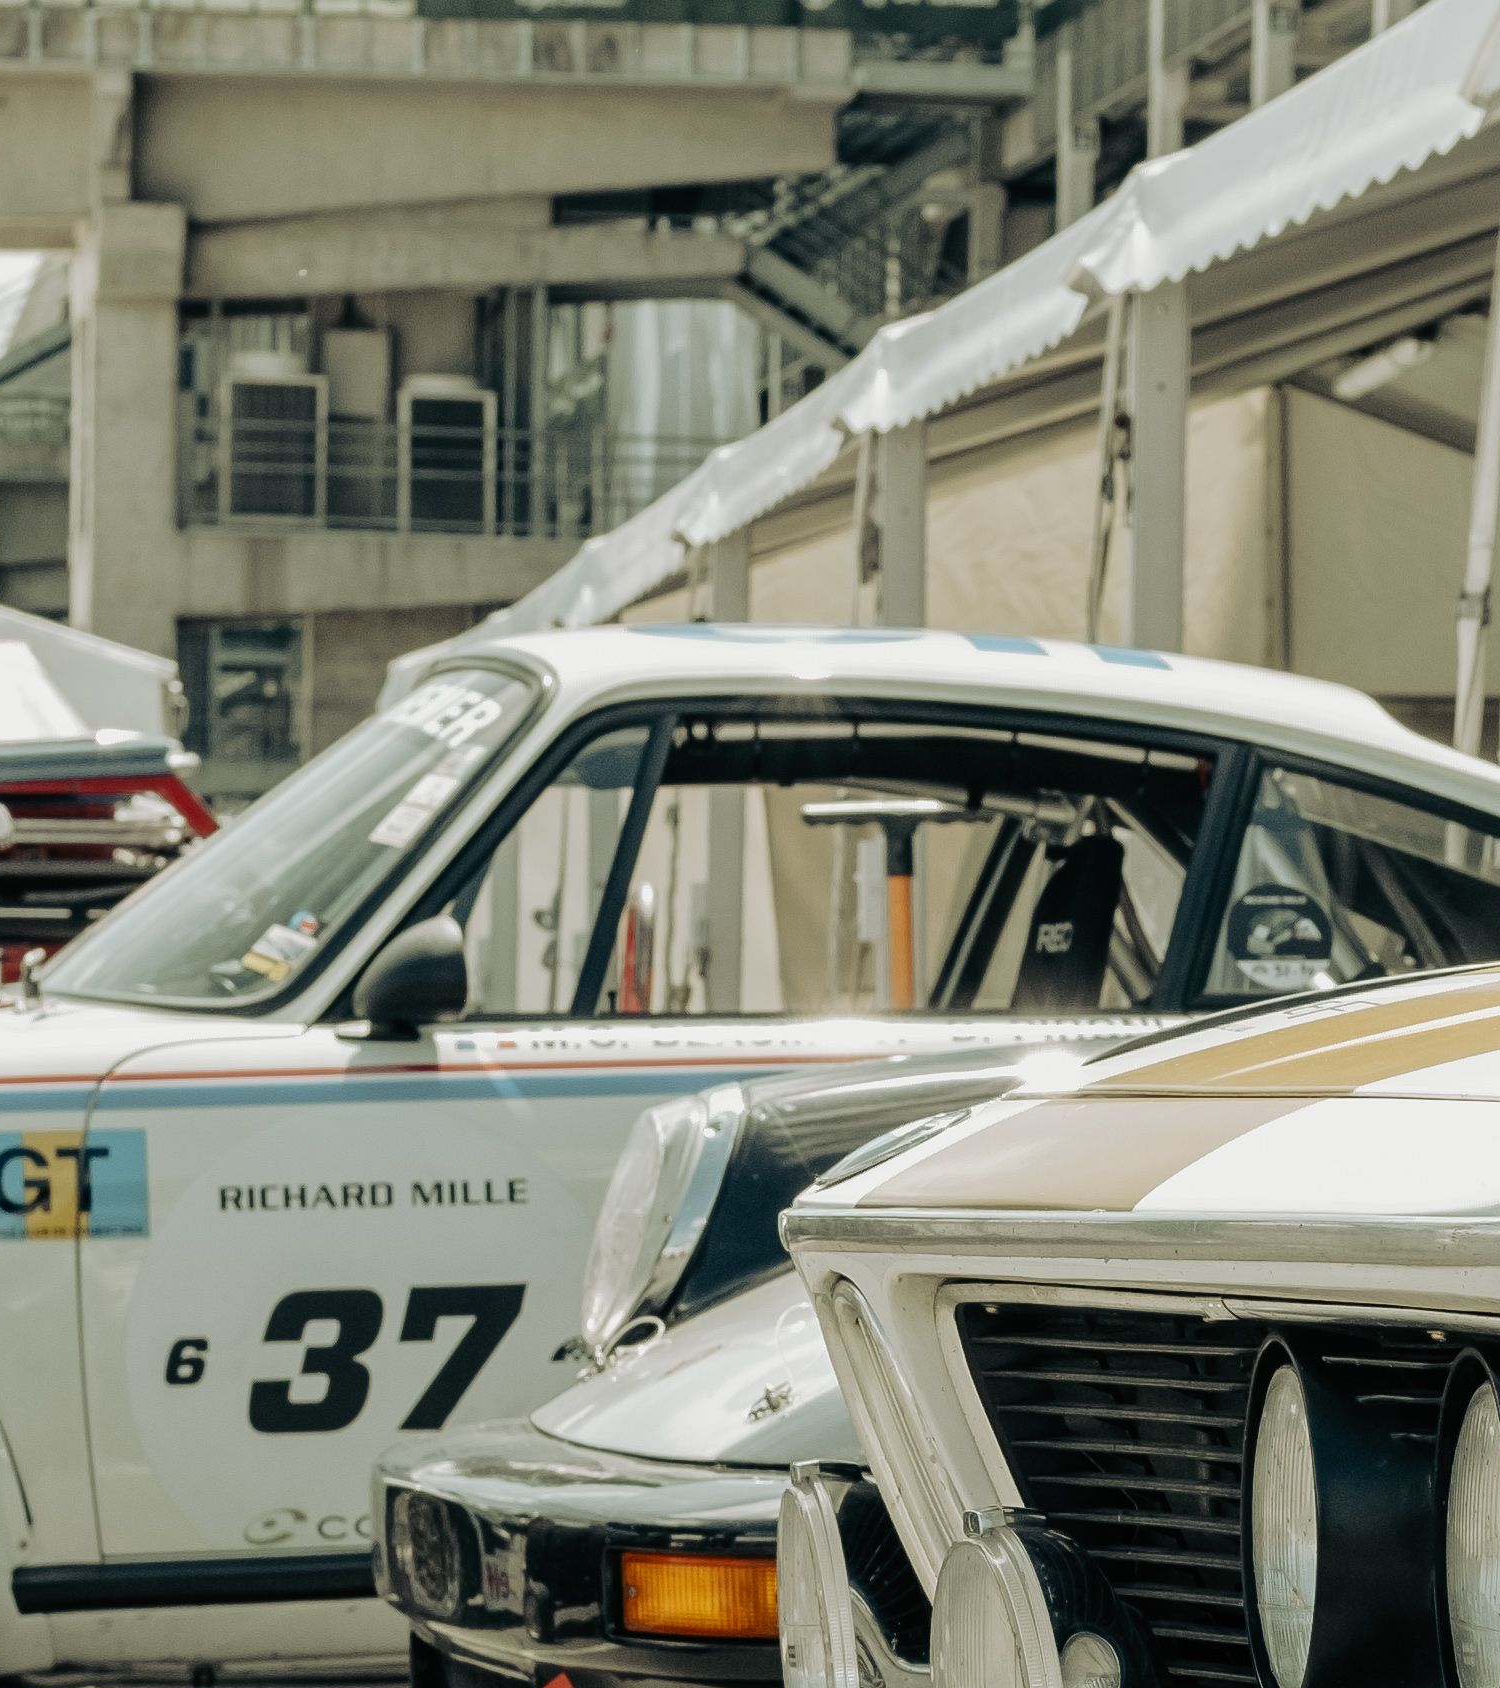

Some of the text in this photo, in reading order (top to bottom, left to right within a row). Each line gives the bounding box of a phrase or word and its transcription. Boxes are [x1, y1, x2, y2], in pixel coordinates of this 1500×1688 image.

[219, 1177, 530, 1212] RICHARD MILLE
[165, 1338, 208, 1386] 6
[249, 1283, 526, 1434] 37
